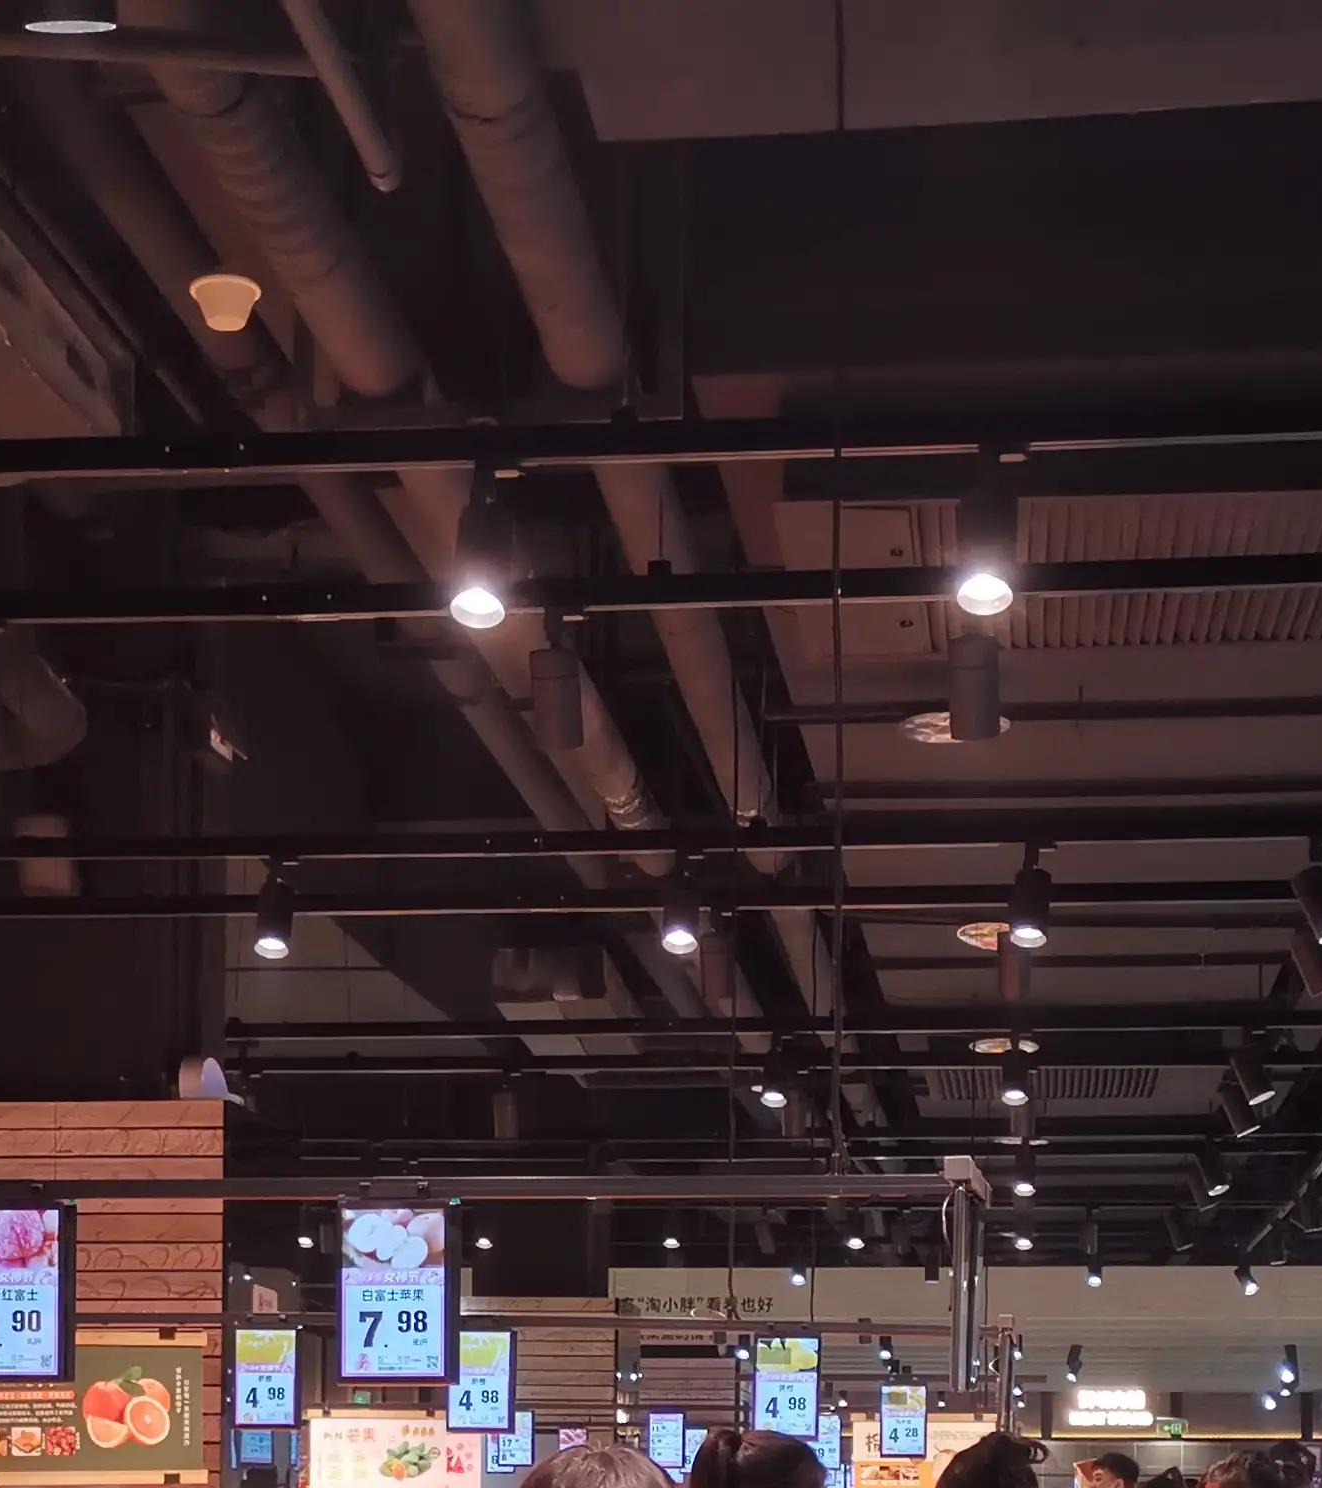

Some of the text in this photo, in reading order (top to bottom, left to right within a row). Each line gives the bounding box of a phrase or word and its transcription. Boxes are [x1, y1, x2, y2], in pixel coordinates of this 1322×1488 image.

[362, 1288, 425, 1301] 白富士苹果
